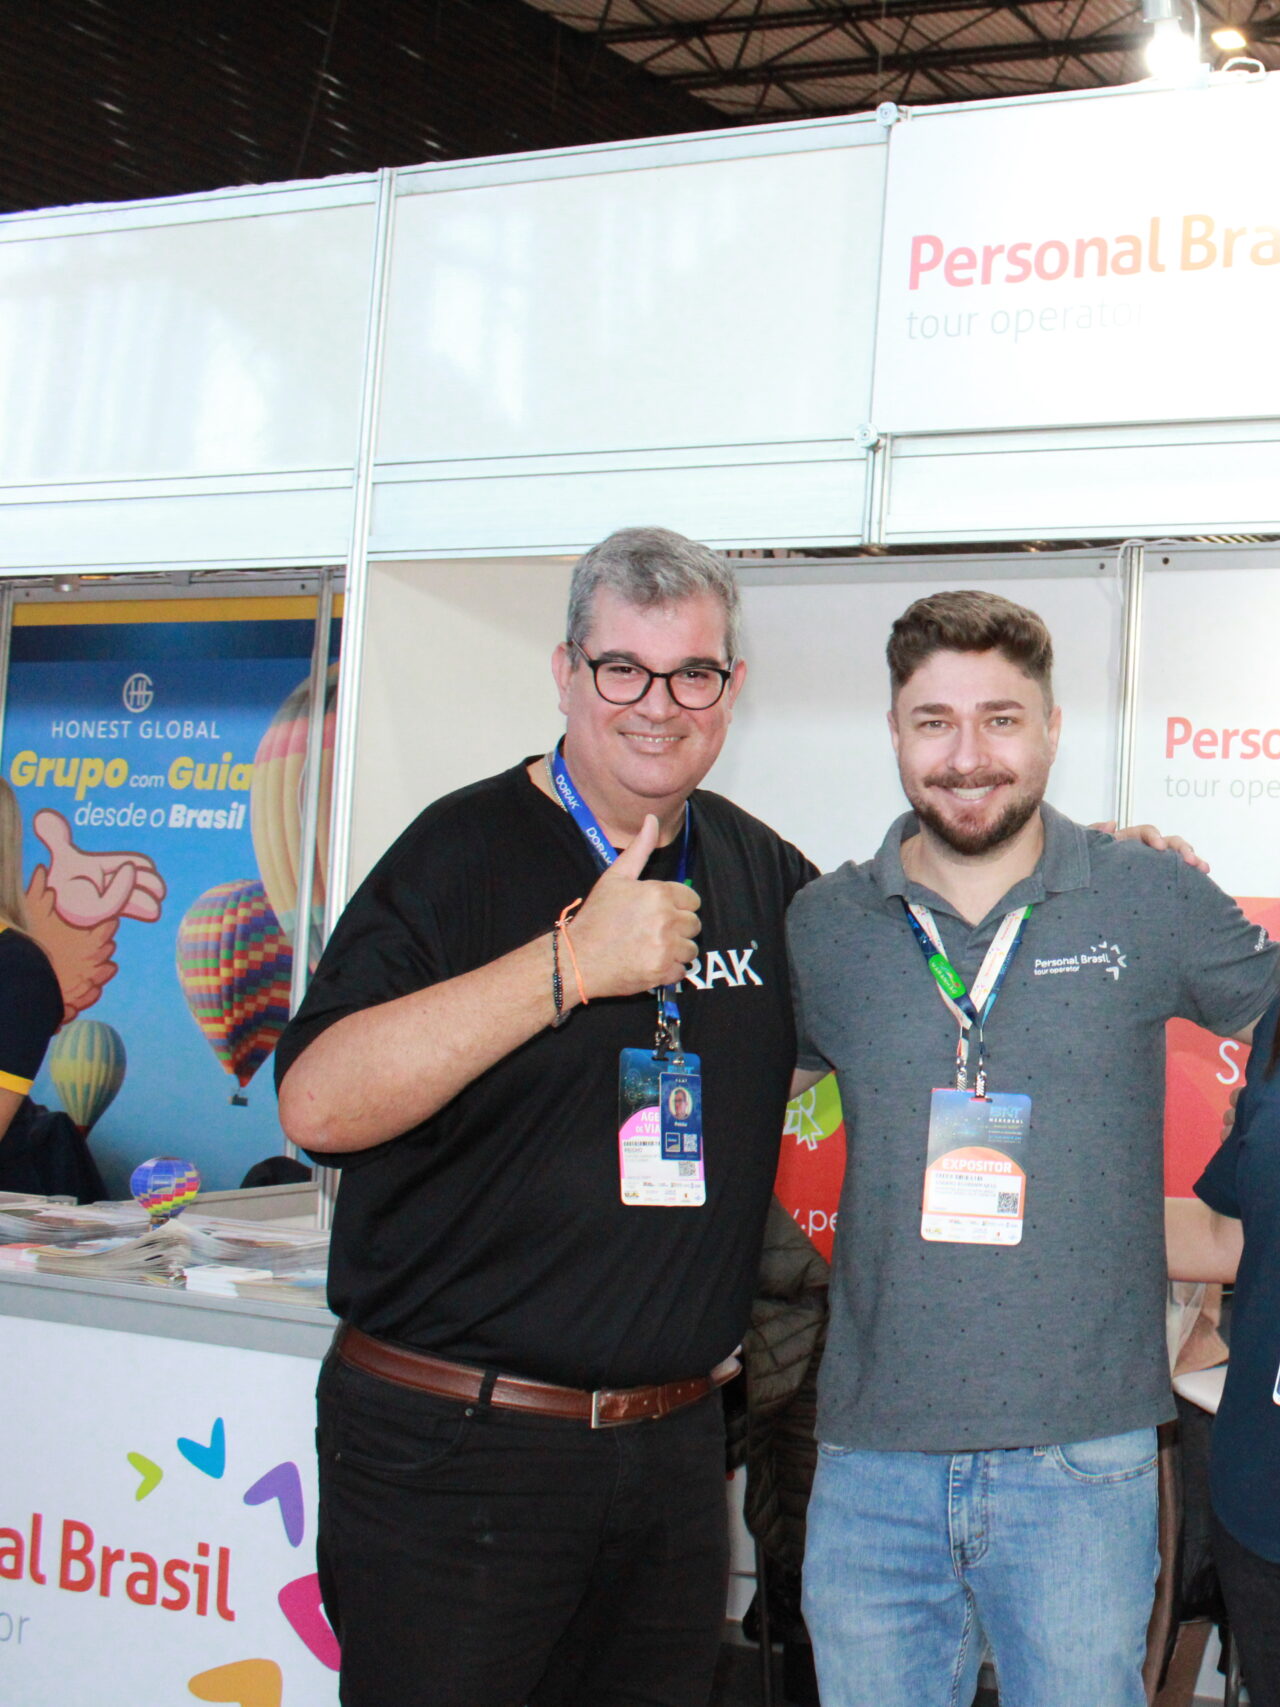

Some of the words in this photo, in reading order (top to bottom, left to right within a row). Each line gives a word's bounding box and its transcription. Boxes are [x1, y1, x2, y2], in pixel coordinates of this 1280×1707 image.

[909, 217, 1165, 290] Personal
[906, 311, 979, 340] tour
[52, 720, 131, 739] HONEST
[139, 720, 221, 739] GLOBAL
[10, 750, 129, 801] Grupo
[129, 774, 165, 788] com
[168, 752, 252, 790] Guia
[1164, 774, 1221, 799] tour
[555, 773, 581, 810] DORAK
[74, 801, 147, 827] desde
[150, 808, 165, 828] o
[168, 801, 247, 830] Brasil
[1033, 968, 1049, 976] tour
[1034, 955, 1080, 969] Personal
[1080, 953, 1111, 965] Brasil
[1215, 1040, 1240, 1085] S
[641, 1111, 661, 1122] AGE
[942, 1158, 1013, 1173] EXPOSITOR
[59, 1519, 236, 1622] Brasil
